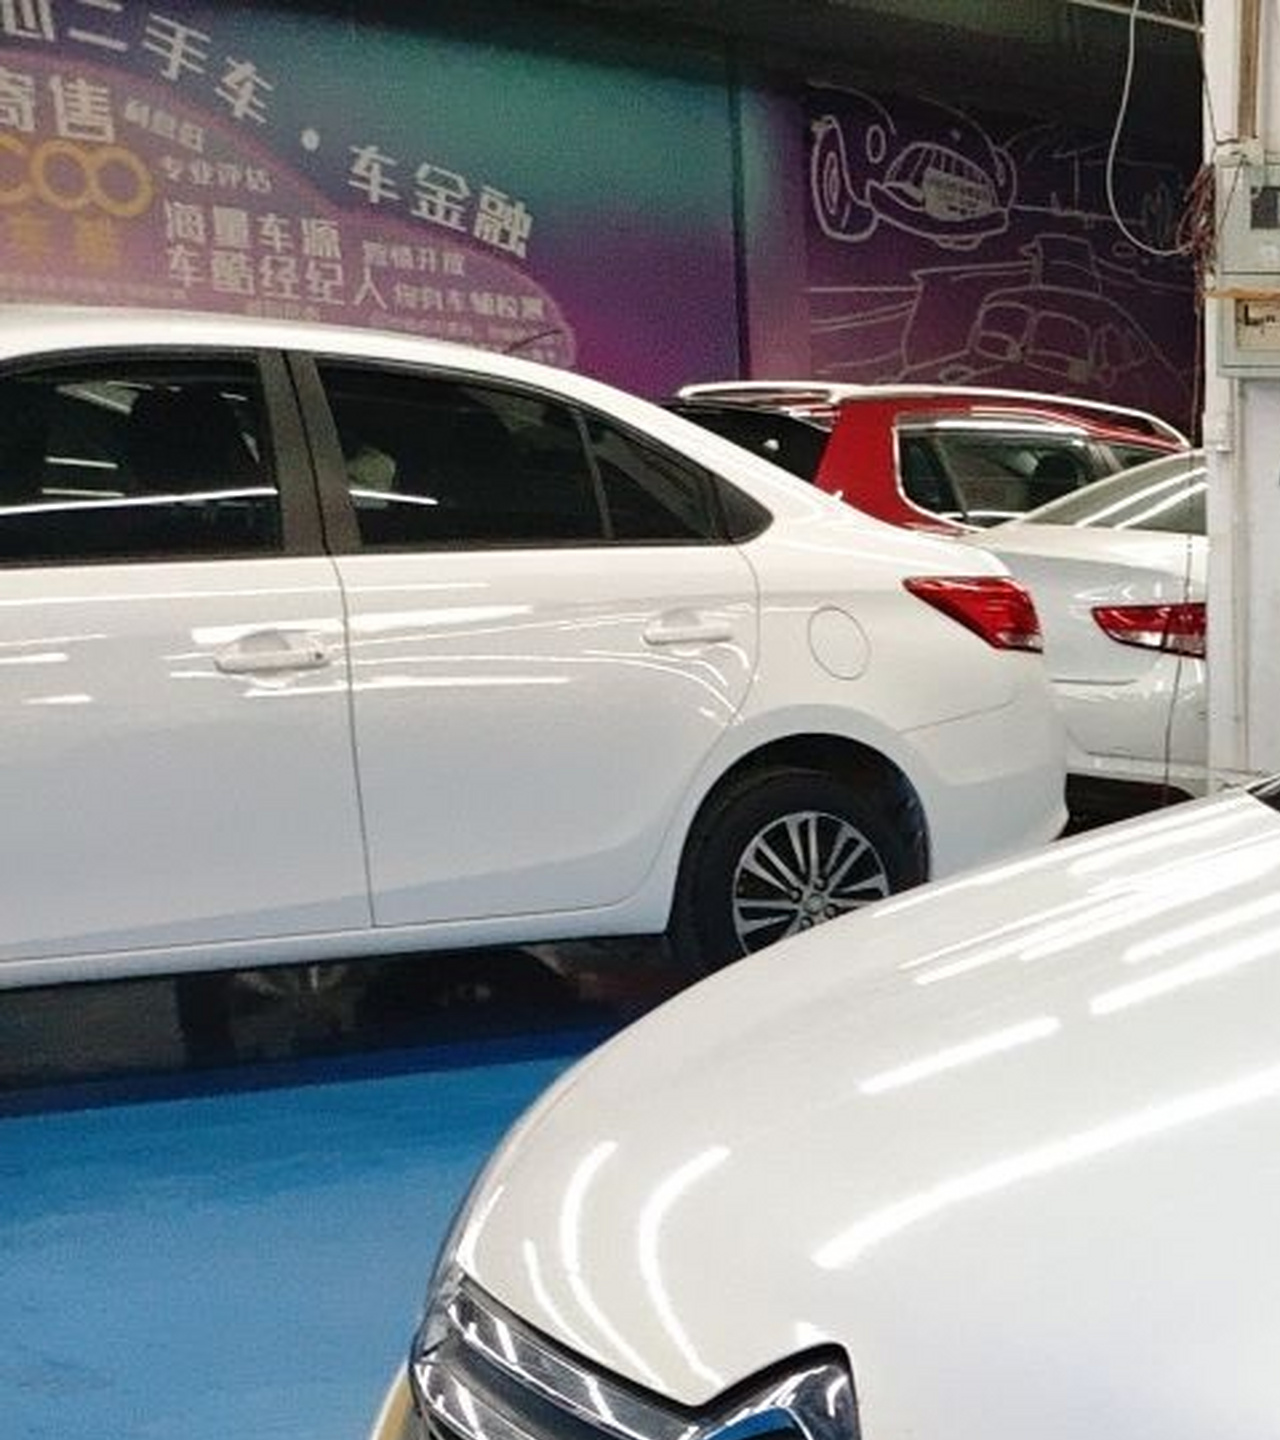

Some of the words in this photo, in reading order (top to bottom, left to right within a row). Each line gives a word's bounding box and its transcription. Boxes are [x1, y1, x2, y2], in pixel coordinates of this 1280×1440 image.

[167, 243, 387, 310] 车酷经纪人
